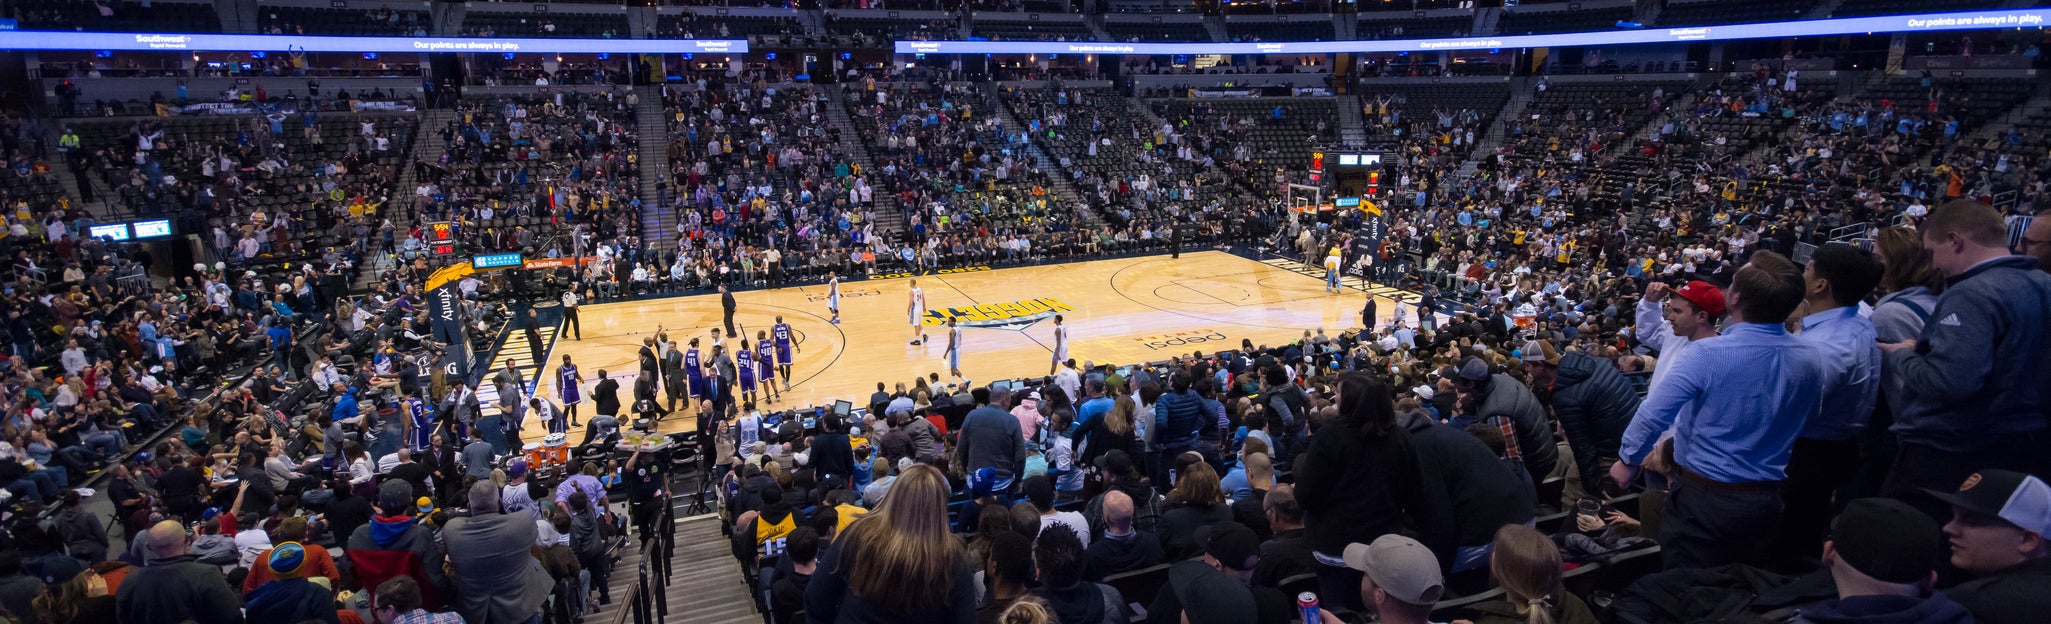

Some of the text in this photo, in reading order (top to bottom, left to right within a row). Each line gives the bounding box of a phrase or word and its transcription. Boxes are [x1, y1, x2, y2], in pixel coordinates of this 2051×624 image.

[1907, 19, 1925, 27] Our
[1926, 17, 1955, 28] points
[1973, 15, 2006, 25] always
[2007, 14, 2018, 23] in
[2019, 13, 2043, 25] play.
[135, 34, 185, 43] Southwest
[413, 41, 429, 49] Our
[430, 41, 454, 50] points
[468, 41, 493, 51] always
[494, 41, 501, 49] in
[438, 287, 455, 321] xfinity
[776, 330, 788, 340] 43
[1144, 332, 1227, 351] pepsi
[760, 347, 772, 357] 40
[687, 357, 696, 367] 41
[738, 358, 750, 368] 24
[416, 405, 423, 416] 3
[765, 537, 787, 556] 15
